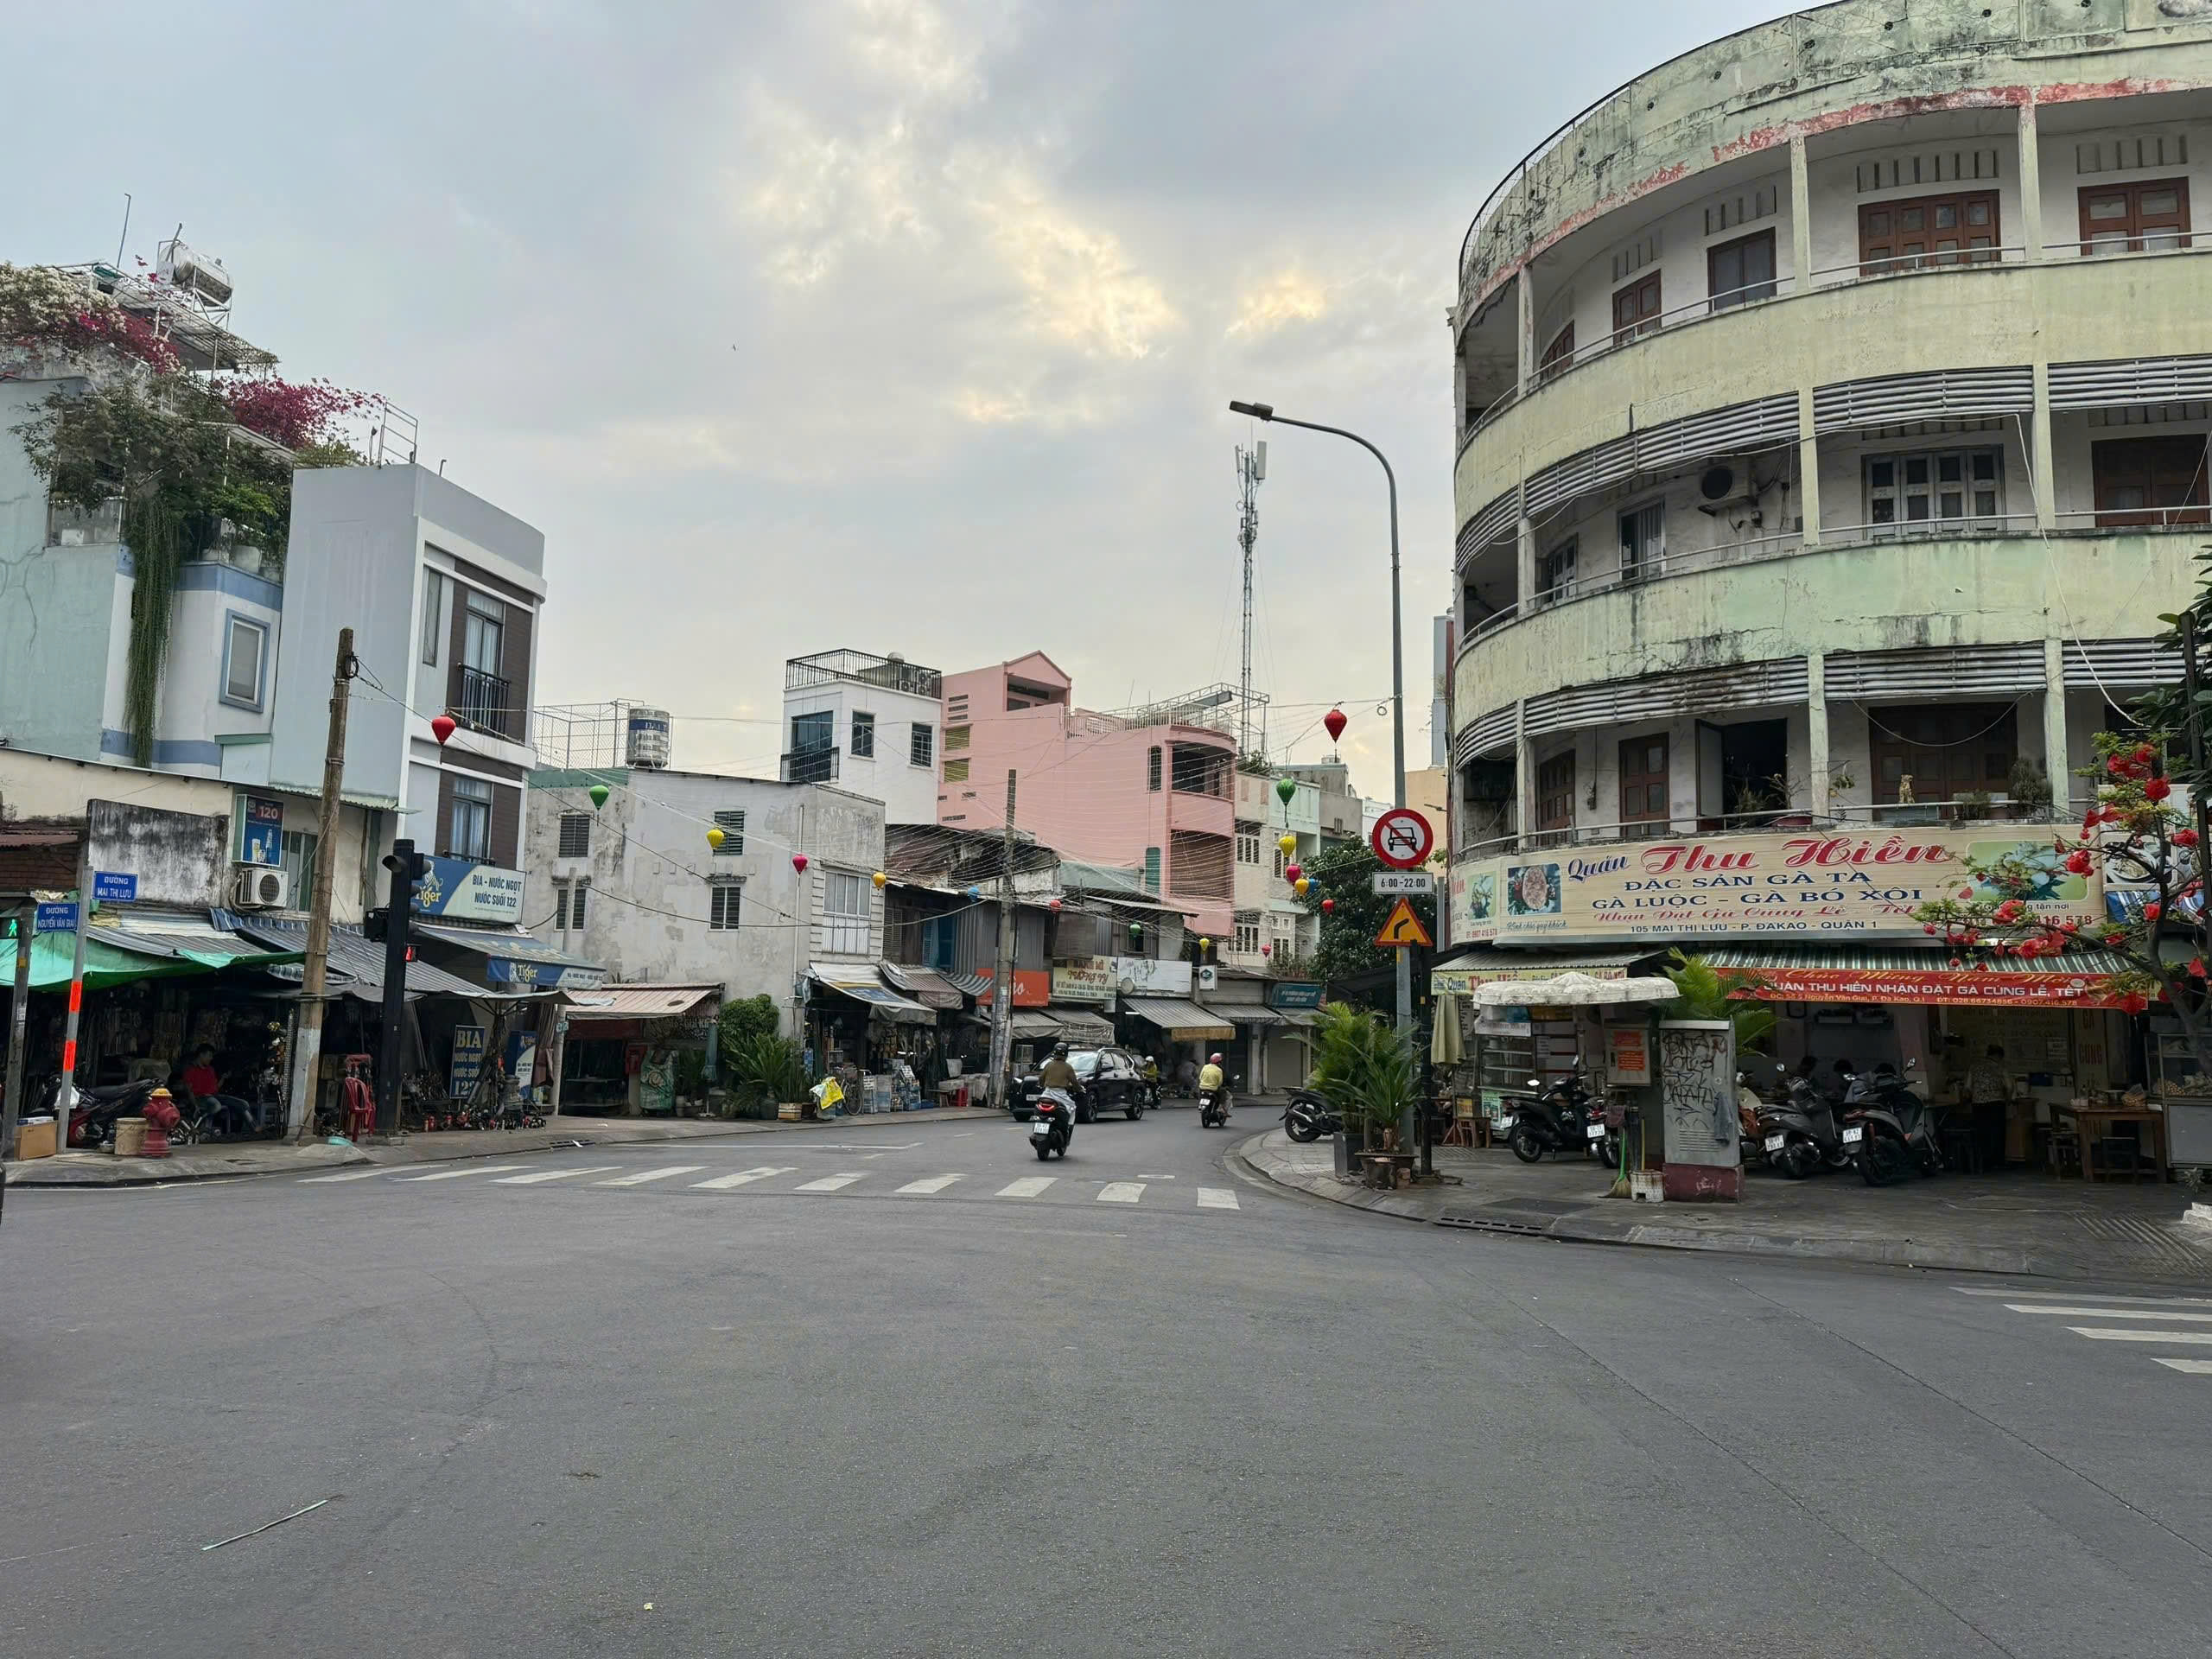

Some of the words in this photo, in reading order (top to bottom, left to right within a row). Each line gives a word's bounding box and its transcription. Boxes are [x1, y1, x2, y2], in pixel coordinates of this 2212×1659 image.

[259, 805, 278, 819] 120
[1567, 855, 1630, 883] Quán
[1641, 844, 1759, 874] Thu
[1781, 835, 1951, 868] Hiền
[472, 874, 483, 887] BIA
[488, 874, 505, 888] NƯỚC
[505, 880, 522, 894] NGỌT
[1624, 878, 1681, 893] ĐẶC
[1693, 874, 1755, 888] SẢN
[1767, 870, 1815, 885] GÀ
[1826, 871, 1872, 883] TA
[97, 887, 108, 897] MAI
[110, 888, 118, 899] THỊ
[474, 891, 491, 905] NƯỚC
[493, 893, 506, 906] SUỐI
[506, 898, 517, 908] 122
[1592, 895, 1626, 909] GÀ
[1635, 893, 1707, 909] LUỘC
[1740, 890, 1789, 905] GÀ
[1799, 887, 1845, 902] BÓ
[1859, 887, 1923, 900] XÔI
[1630, 925, 1648, 933] 105
[1677, 924, 1697, 933] THỊ
[1701, 923, 1727, 932] LỰU
[1756, 922, 1807, 931] ĐAKAO
[1821, 921, 1865, 931] QUẬN
[2066, 915, 2093, 925] 578
[518, 962, 537, 982] Tiger
[1808, 983, 1836, 992] THU
[1876, 982, 1918, 995] NHẬN
[1922, 983, 1953, 995] ĐẶT
[1958, 983, 1979, 995] GÀ
[456, 1029, 482, 1048] BIA
